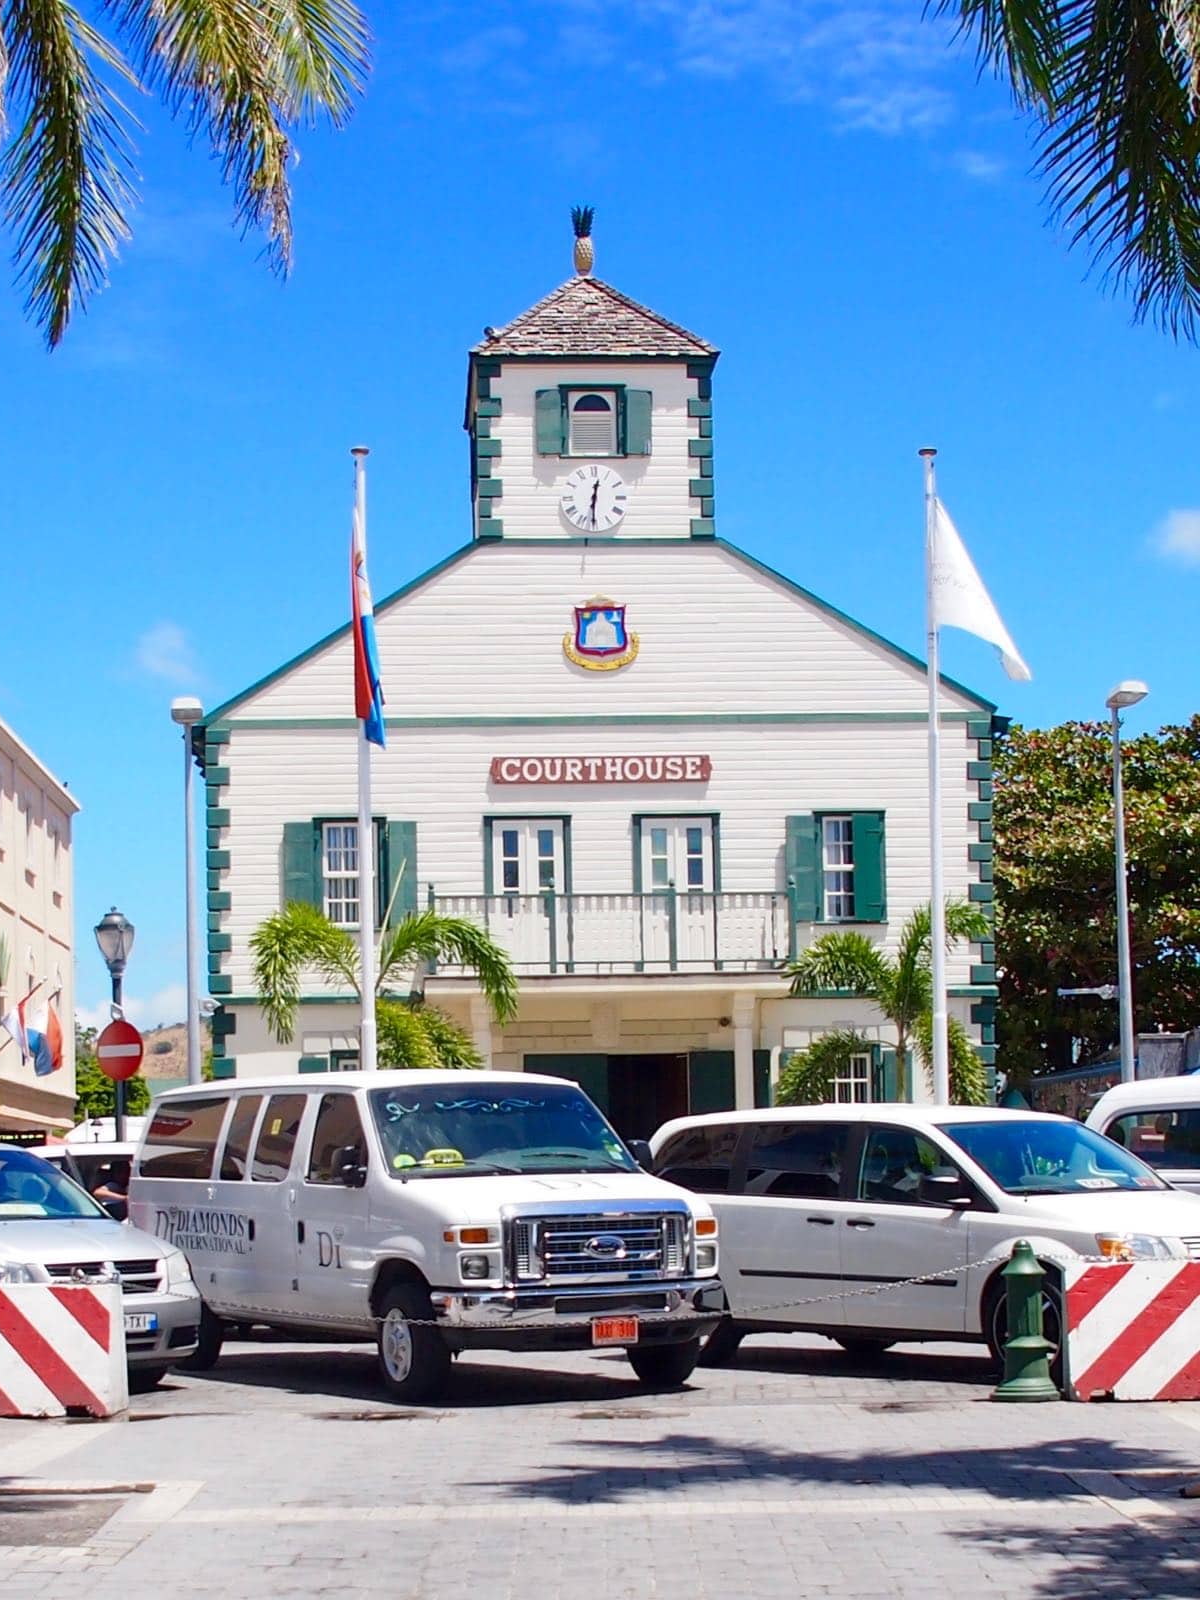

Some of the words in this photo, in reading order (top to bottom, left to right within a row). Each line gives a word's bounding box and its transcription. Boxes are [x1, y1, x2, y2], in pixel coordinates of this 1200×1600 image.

[501, 757, 701, 782] COURTHOUSE
[176, 1210, 246, 1238] DIAMONDS
[175, 1233, 246, 1255] INTERNATIONAL
